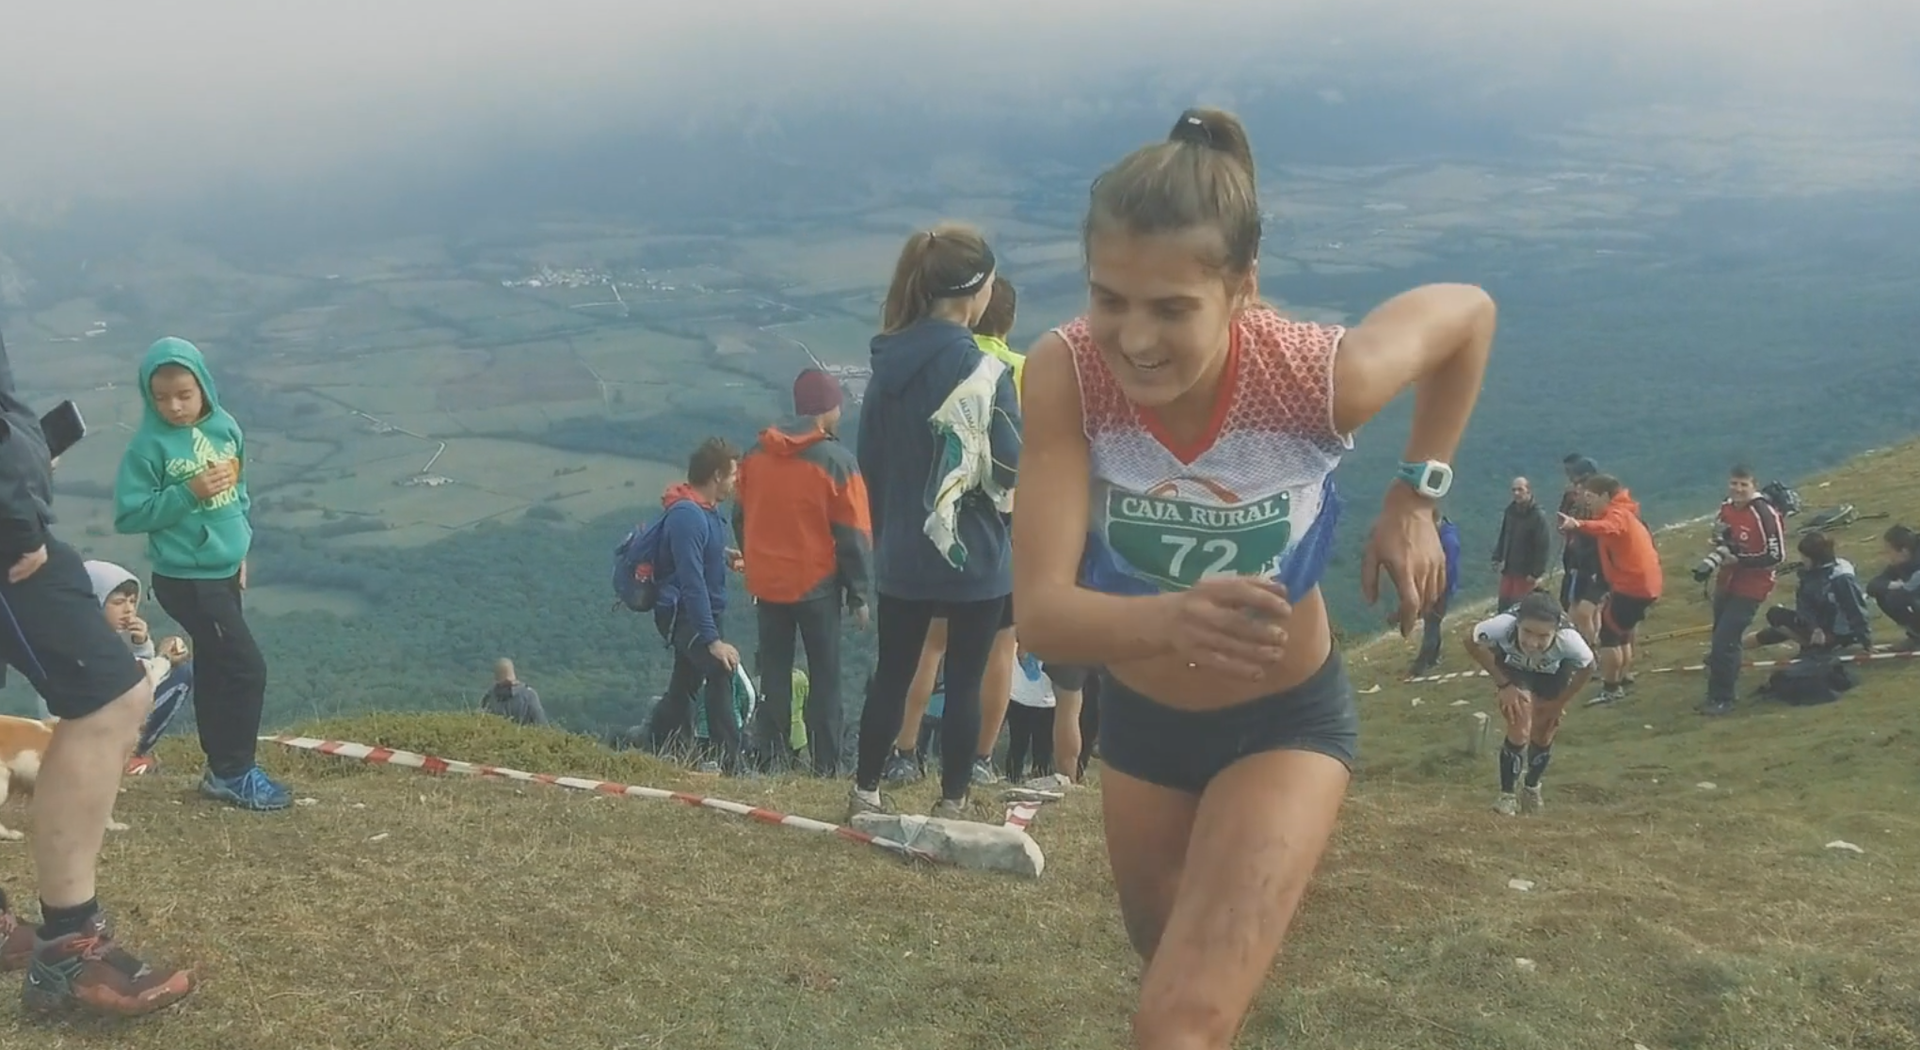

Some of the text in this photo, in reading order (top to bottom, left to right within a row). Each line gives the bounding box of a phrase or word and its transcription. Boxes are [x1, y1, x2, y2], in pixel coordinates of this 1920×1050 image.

[1121, 497, 1279, 527] CAJA RURAL
[1161, 535, 1238, 580] 72
